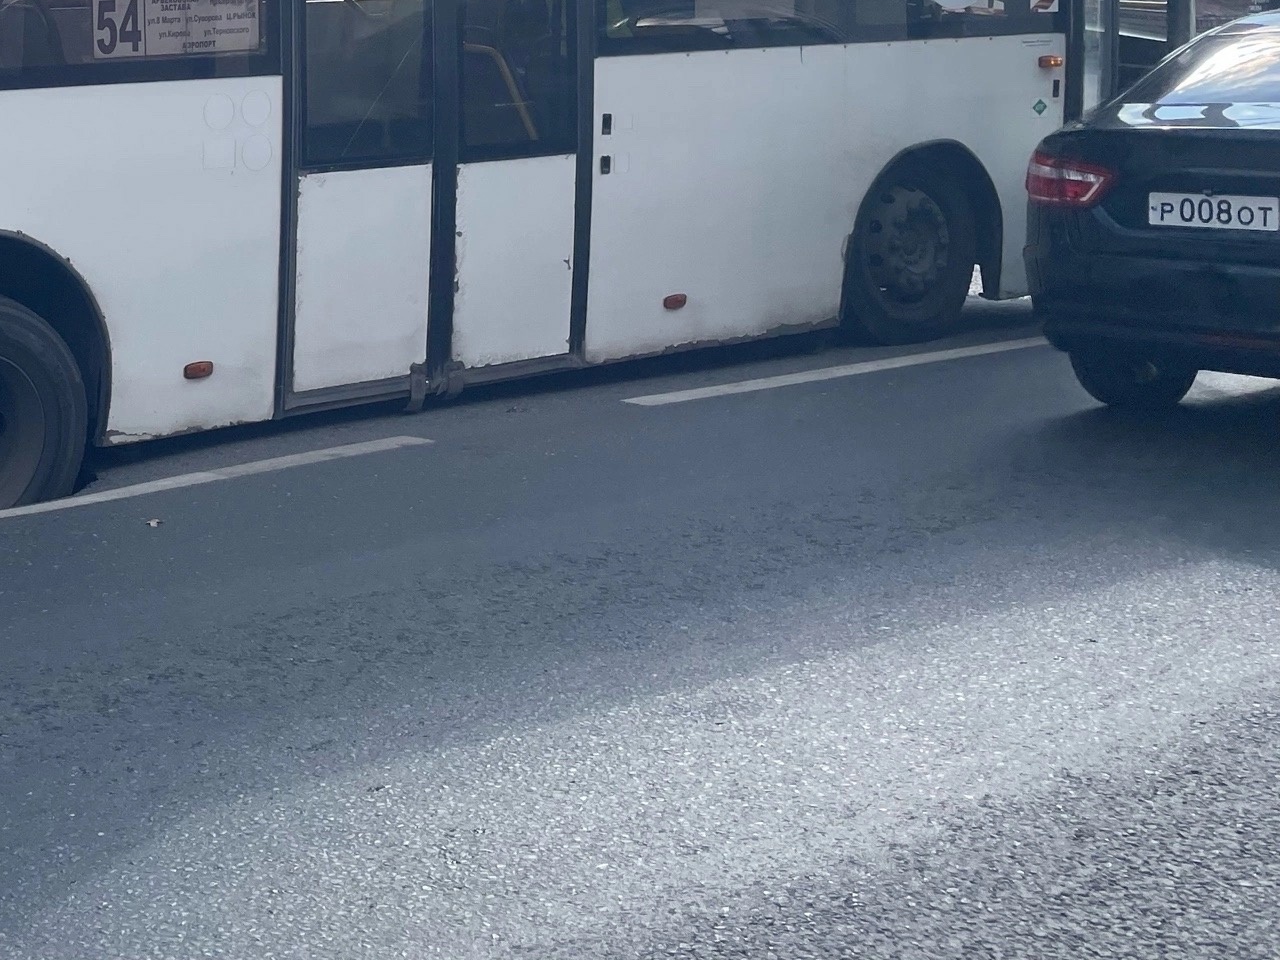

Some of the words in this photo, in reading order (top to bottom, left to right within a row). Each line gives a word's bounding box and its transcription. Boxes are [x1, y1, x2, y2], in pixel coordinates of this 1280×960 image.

[160, 3, 192, 12] ЗАСТАВА
[182, 40, 217, 49] АЭРОПОРТ
[1160, 197, 1273, 227] Р008ОТ
